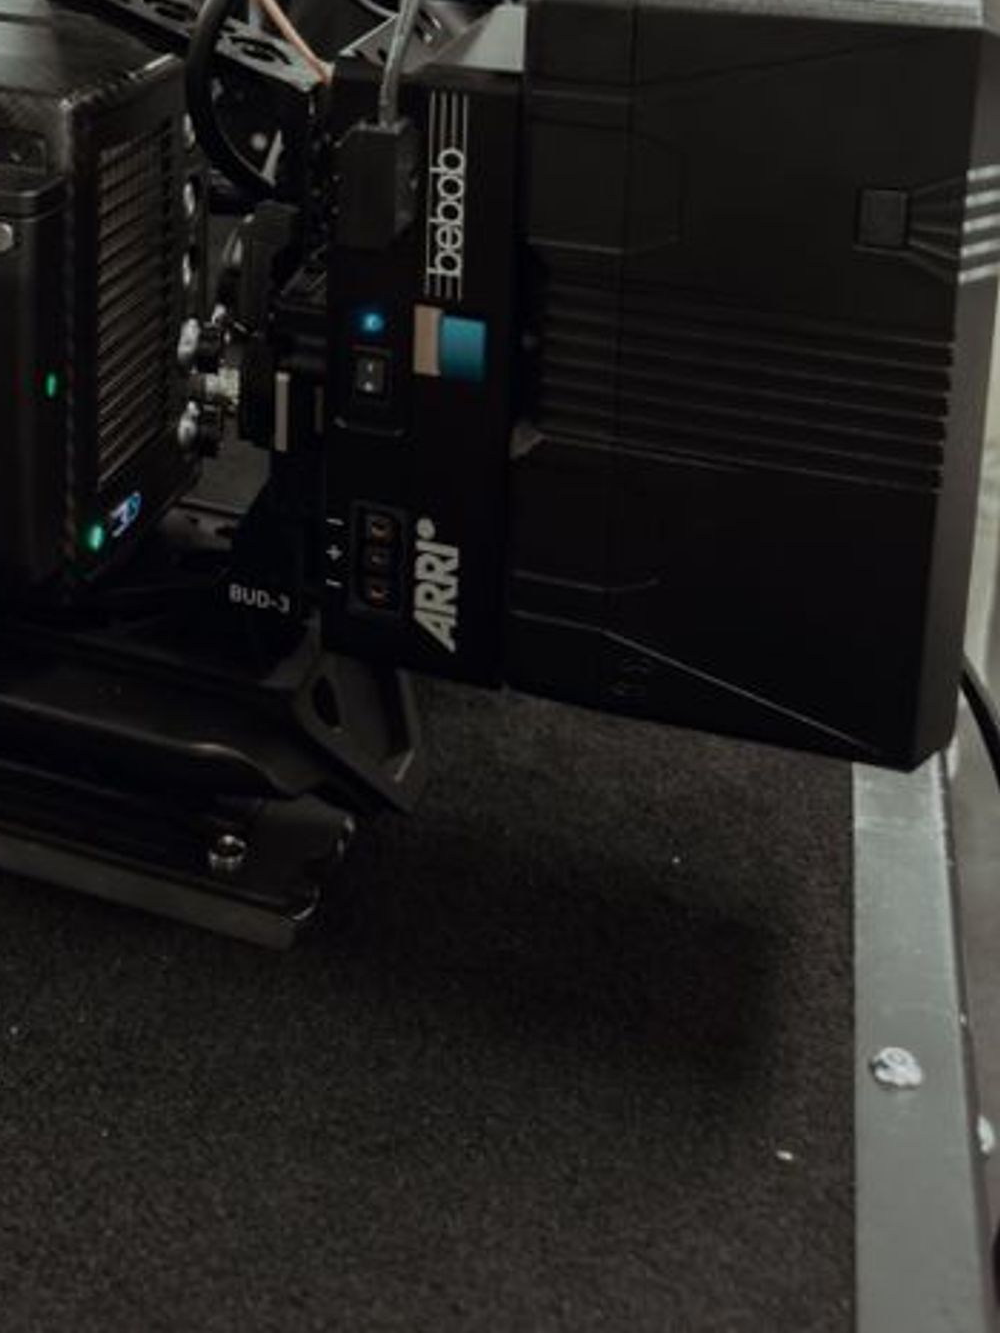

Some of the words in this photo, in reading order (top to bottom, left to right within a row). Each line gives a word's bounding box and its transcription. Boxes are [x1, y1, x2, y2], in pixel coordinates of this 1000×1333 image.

[426, 147, 466, 278] bebob
[229, 582, 291, 615] BUD-3
[413, 538, 460, 655] ARRI
